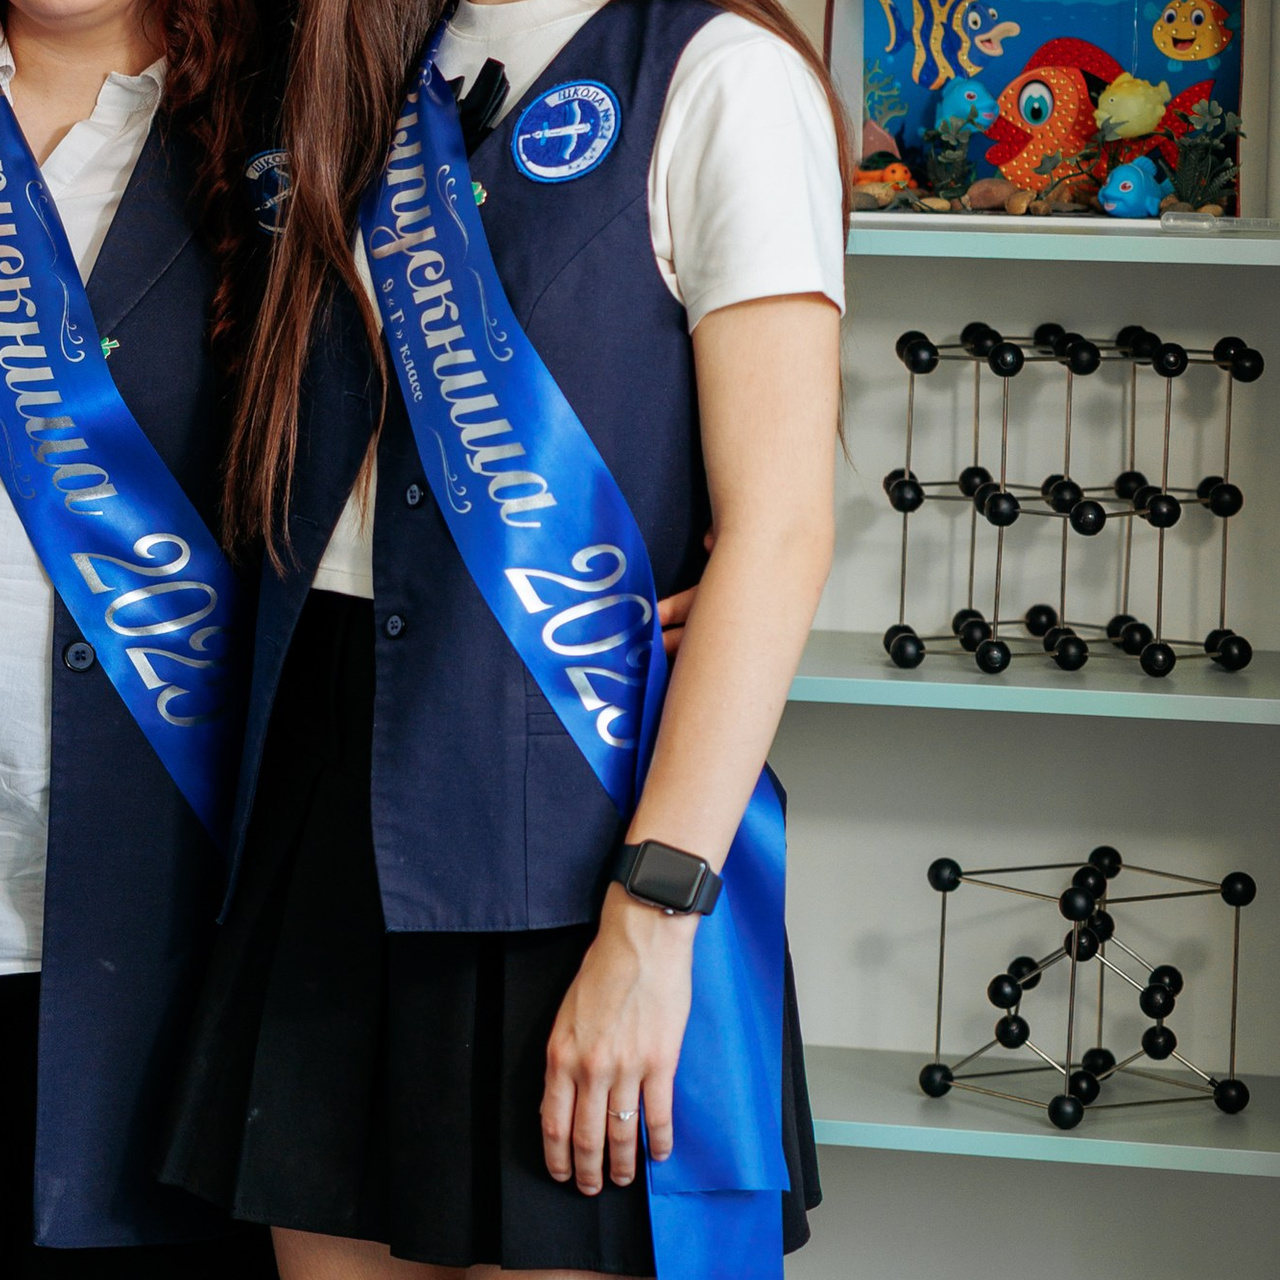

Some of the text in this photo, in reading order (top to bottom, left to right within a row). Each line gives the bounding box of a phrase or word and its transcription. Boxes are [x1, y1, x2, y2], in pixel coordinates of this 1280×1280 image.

[557, 87, 605, 109] ШКОЛА
[369, 93, 559, 528] ыпускница
[382, 278, 395, 293] 9
[399, 343, 424, 403] класс
